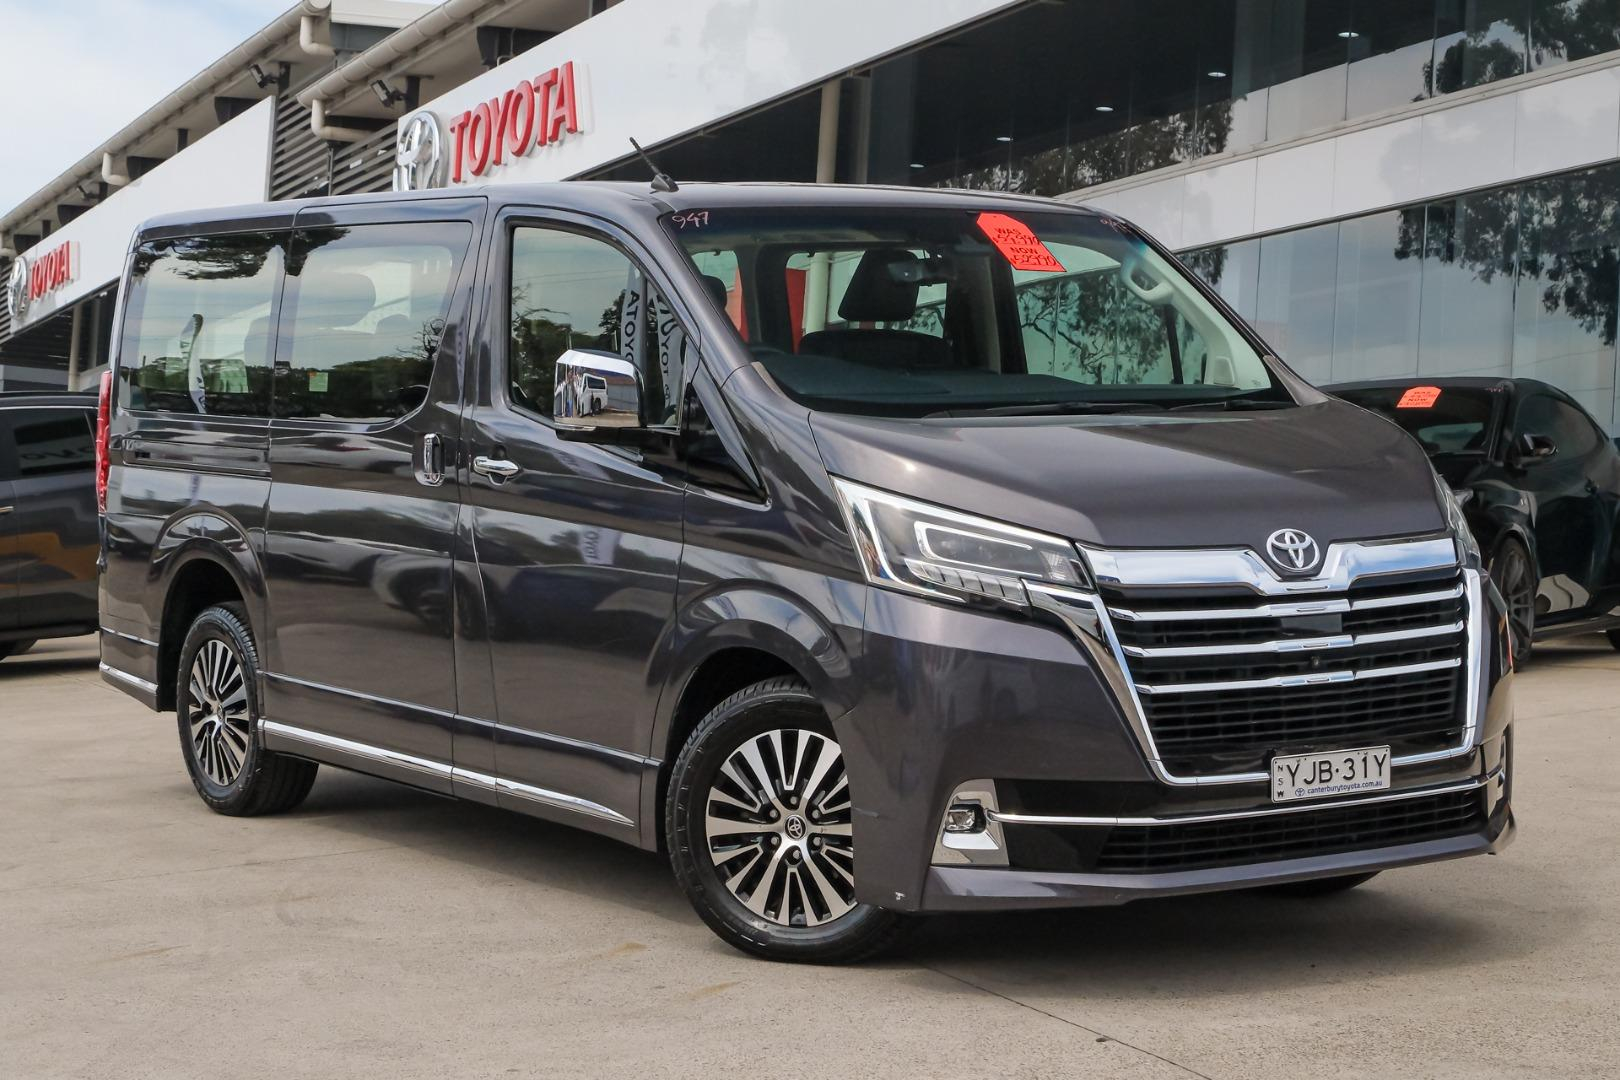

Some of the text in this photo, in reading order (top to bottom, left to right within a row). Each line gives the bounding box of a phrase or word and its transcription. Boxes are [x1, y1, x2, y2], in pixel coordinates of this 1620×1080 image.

[450, 60, 579, 183] TOYOTA
[672, 211, 709, 229] 947
[994, 227, 1021, 235] WAS
[1010, 247, 1038, 255] NOW
[29, 240, 71, 301] TOYOTA
[1307, 780, 1383, 795] canterburytoyota.com.au
